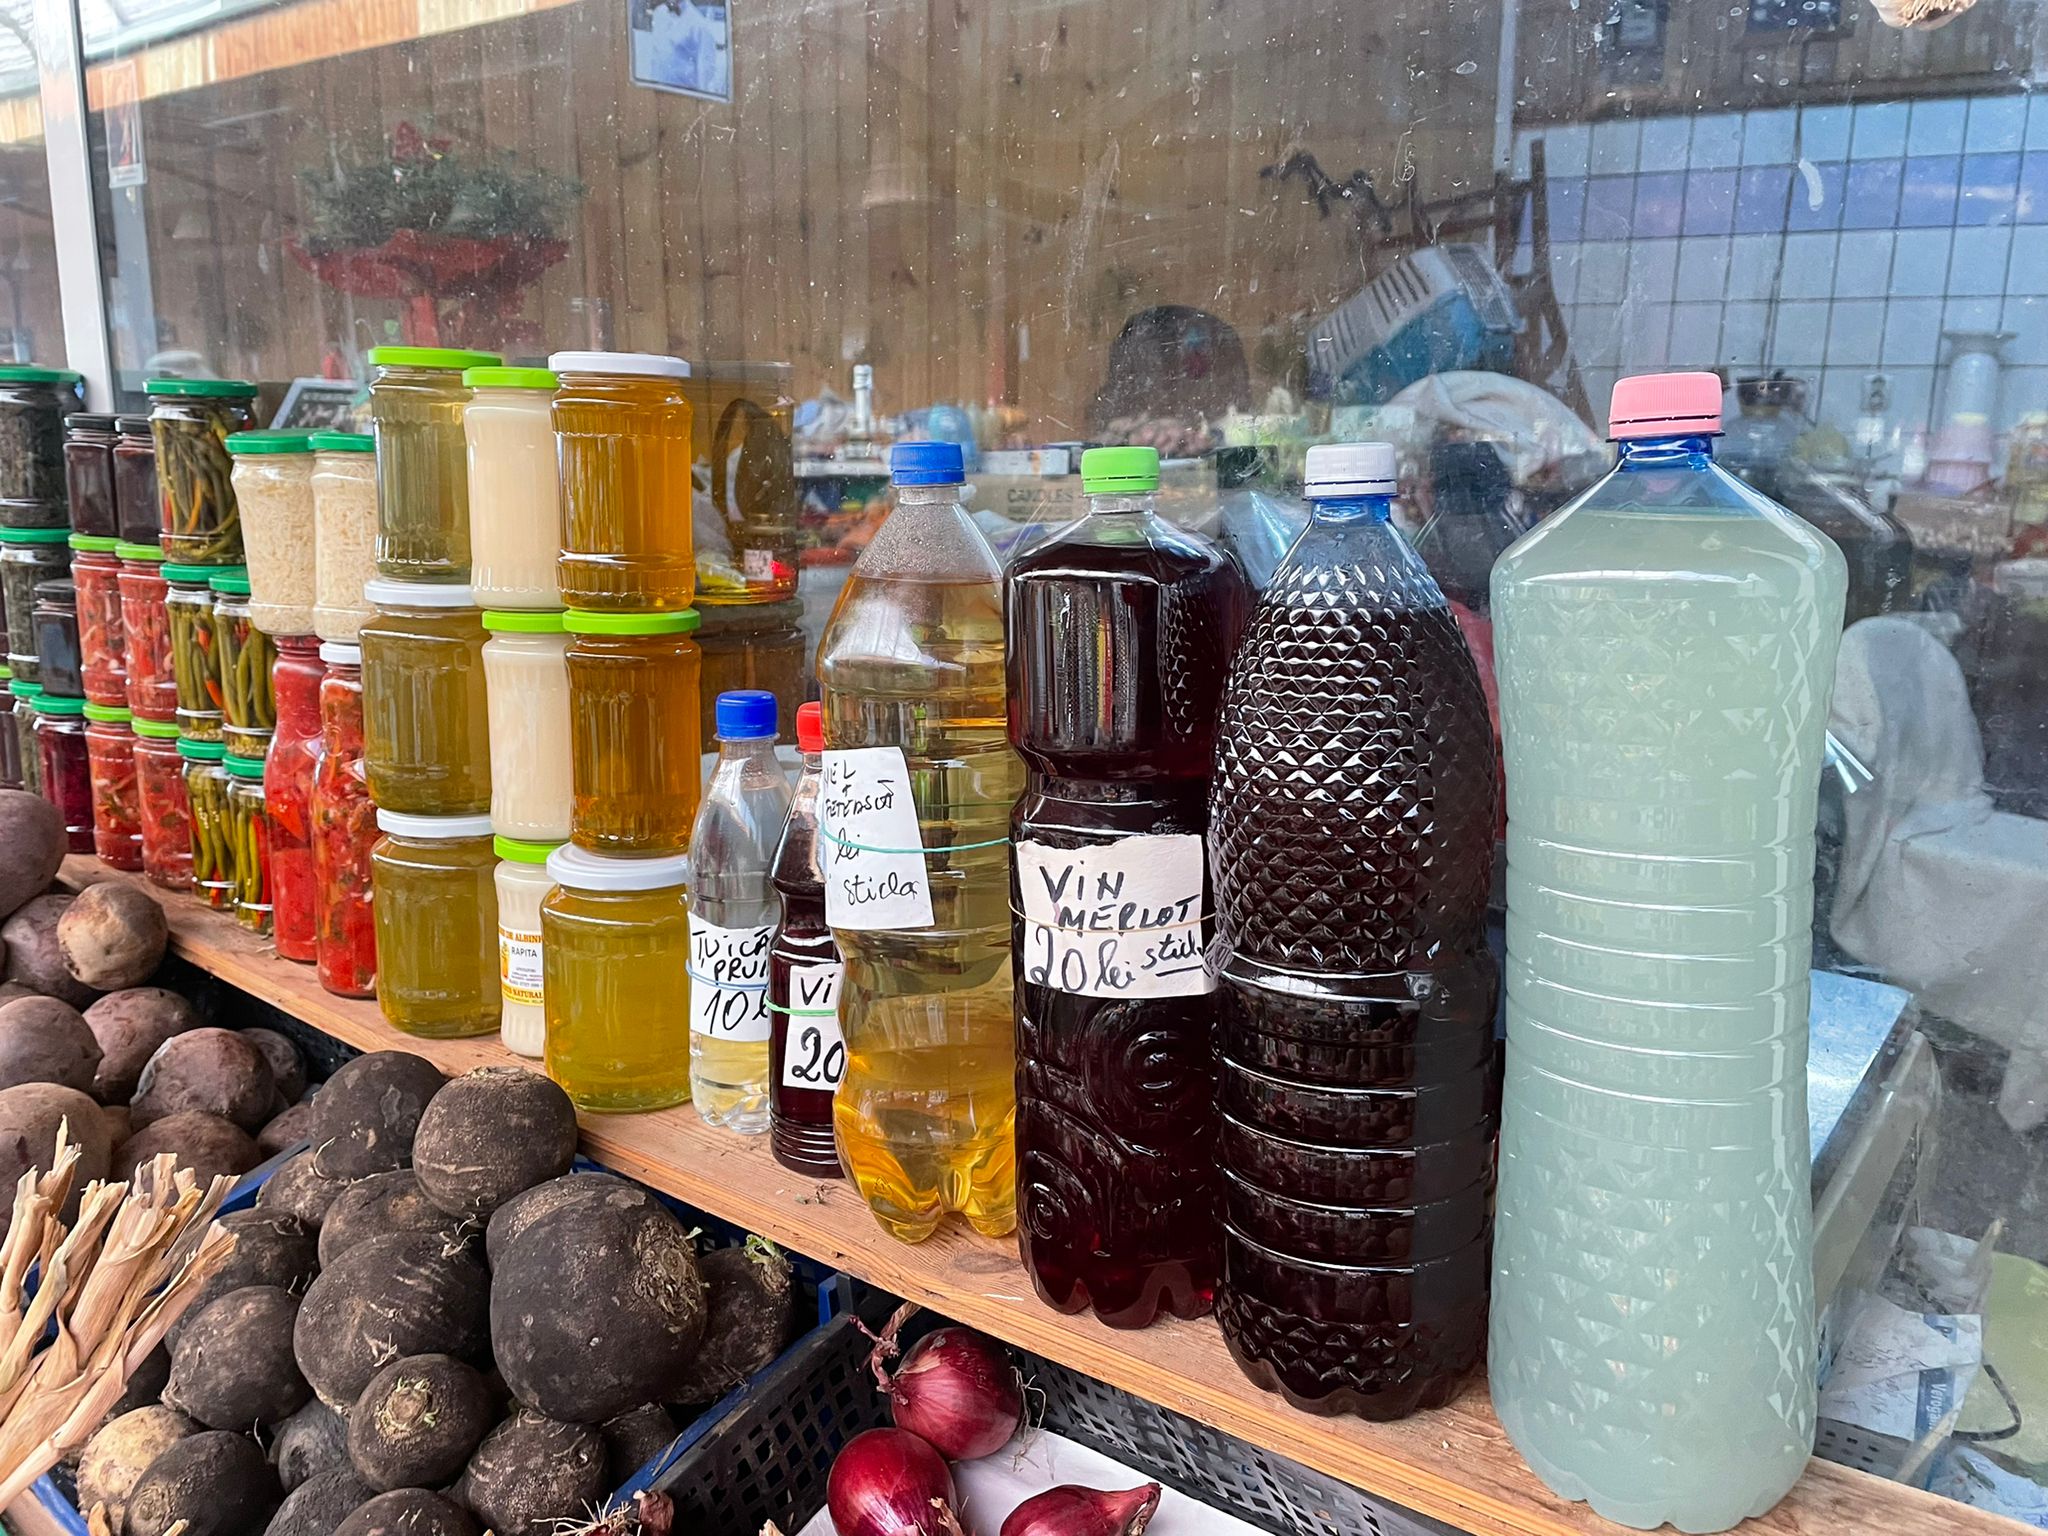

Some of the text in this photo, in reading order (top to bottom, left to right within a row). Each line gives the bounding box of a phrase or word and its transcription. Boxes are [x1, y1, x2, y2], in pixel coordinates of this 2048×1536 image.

[511, 946, 538, 958] RAPITA
[1030, 927, 1087, 992] 20
[1094, 939, 1136, 991] lei
[704, 989, 749, 1034] 10
[791, 1026, 845, 1084] 20
